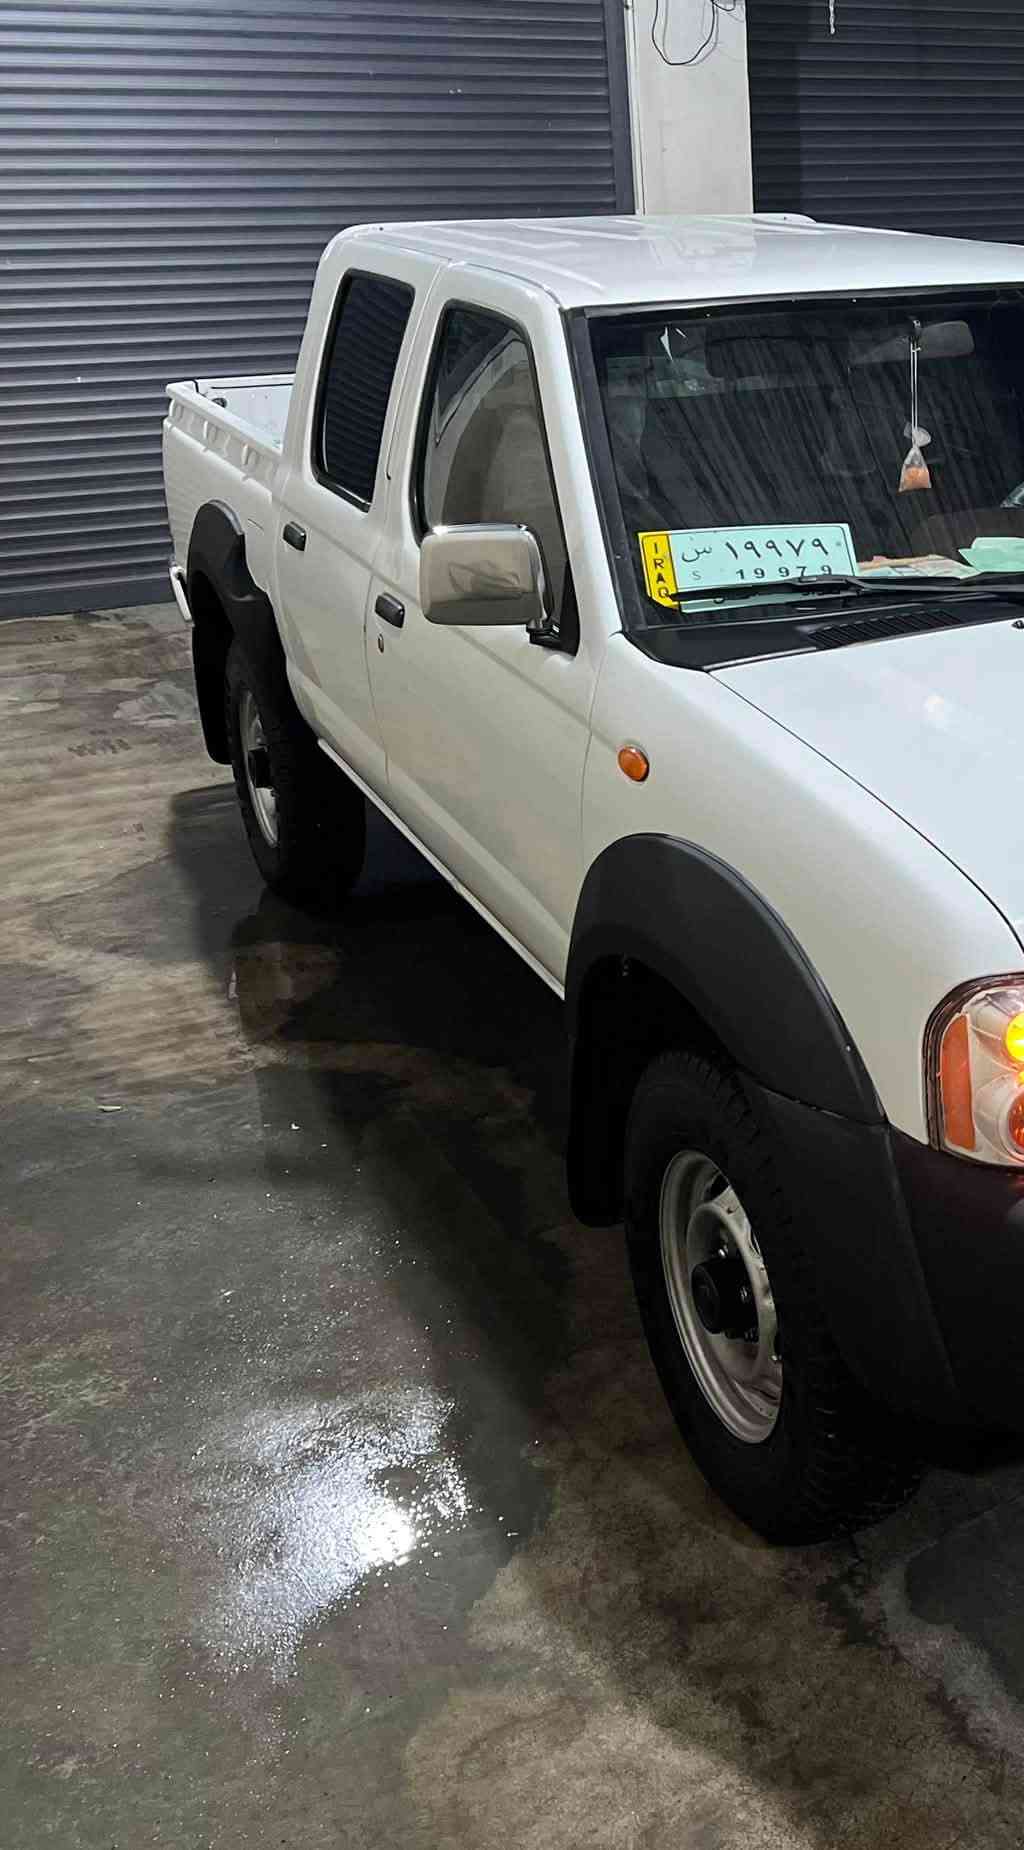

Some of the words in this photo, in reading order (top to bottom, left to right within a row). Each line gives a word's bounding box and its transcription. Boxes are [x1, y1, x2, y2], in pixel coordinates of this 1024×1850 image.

[725, 537, 829, 560] ١٩٩٧٩
[653, 542, 671, 599] IRAQ
[735, 564, 832, 581] 19979
